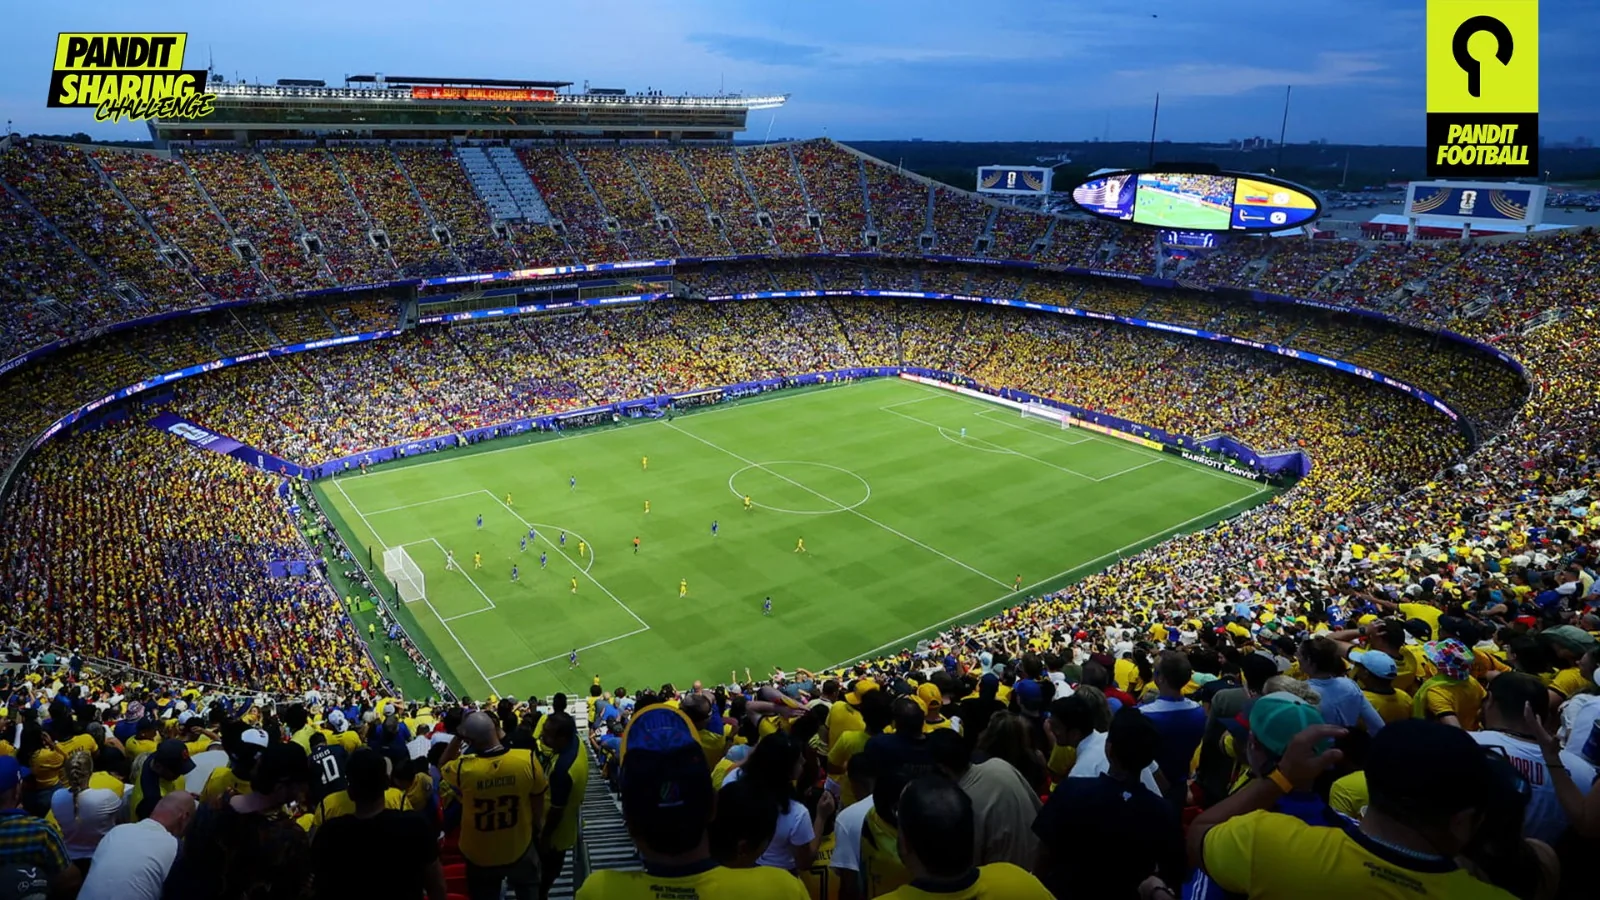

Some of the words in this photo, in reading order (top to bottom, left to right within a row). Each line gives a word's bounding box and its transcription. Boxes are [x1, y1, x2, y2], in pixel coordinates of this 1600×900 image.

[443, 88, 465, 98] SUPER
[468, 89, 486, 98] BOWL
[488, 89, 527, 99] CHAMPIONS
[343, 284, 373, 292] KANSAS
[1181, 451, 1221, 469] MARRIOTT
[473, 794, 520, 832] 23
